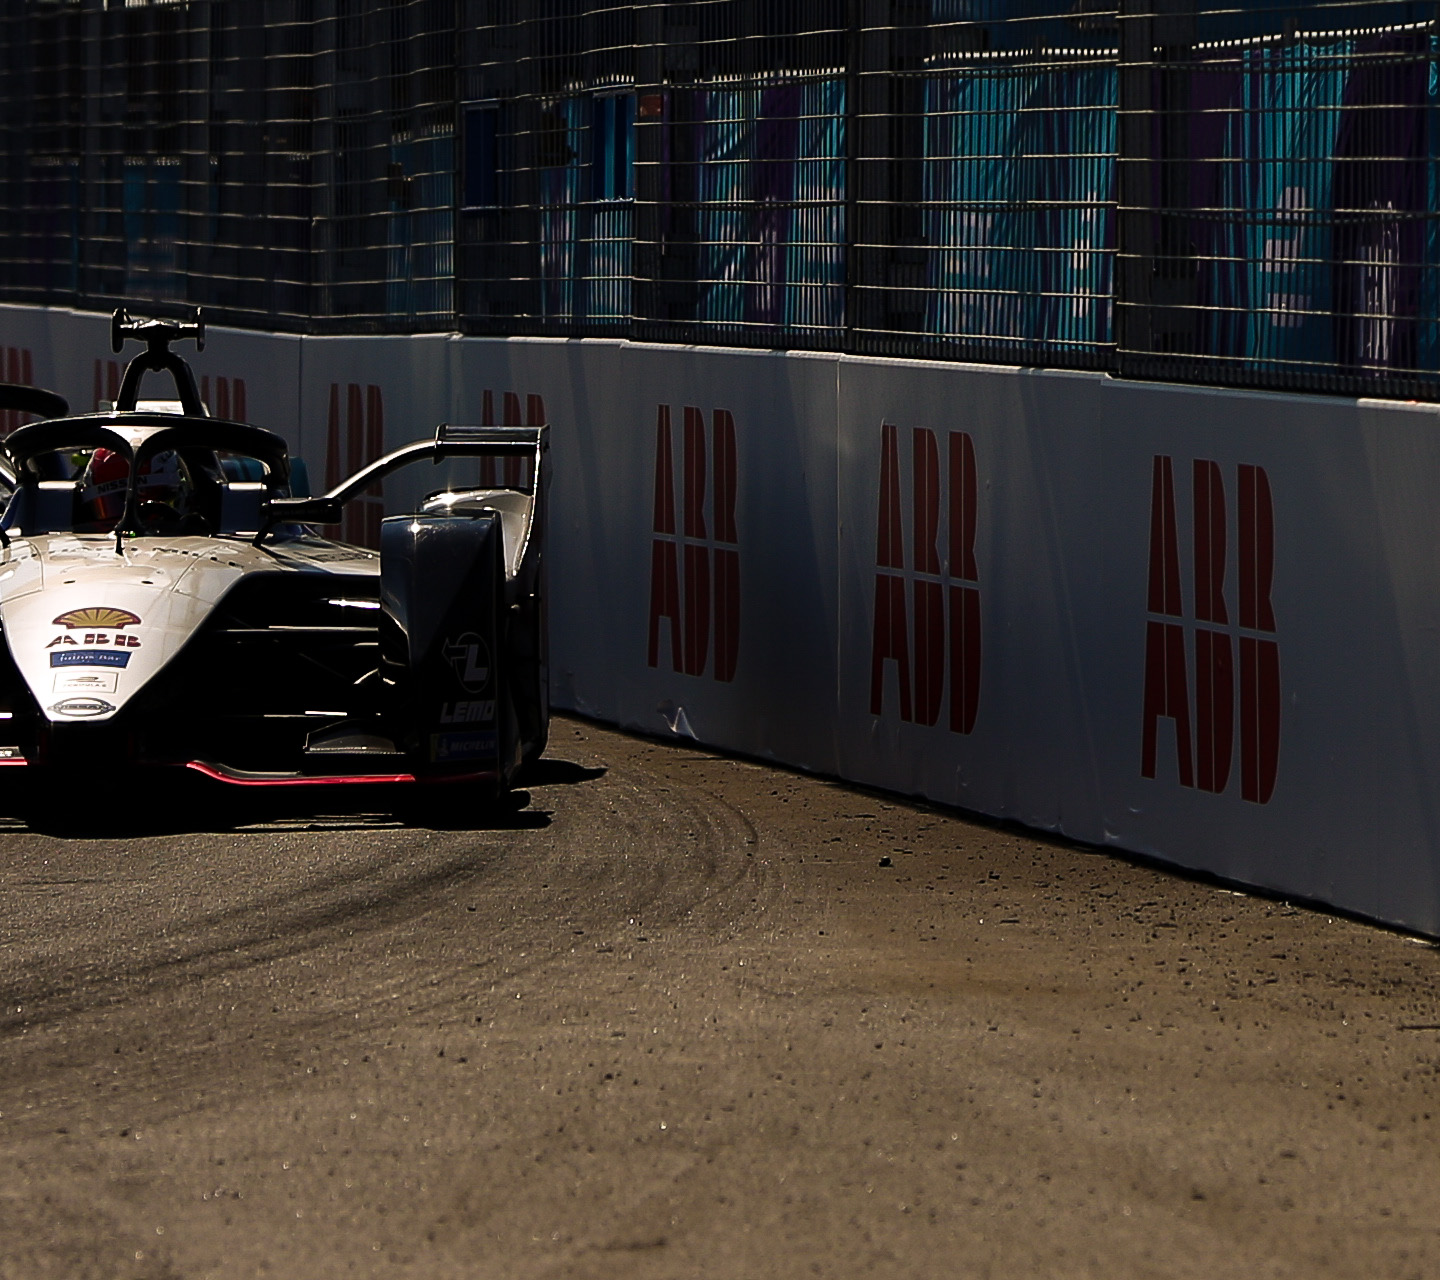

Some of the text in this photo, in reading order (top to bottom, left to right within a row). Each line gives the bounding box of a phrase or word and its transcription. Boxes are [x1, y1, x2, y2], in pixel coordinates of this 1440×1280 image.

[98, 475, 148, 493] NISSN
[648, 404, 741, 682] ABB
[45, 633, 142, 648] ABB
[871, 425, 981, 733] ABB
[1142, 456, 1281, 804] ABB
[440, 699, 497, 725] LEMO
